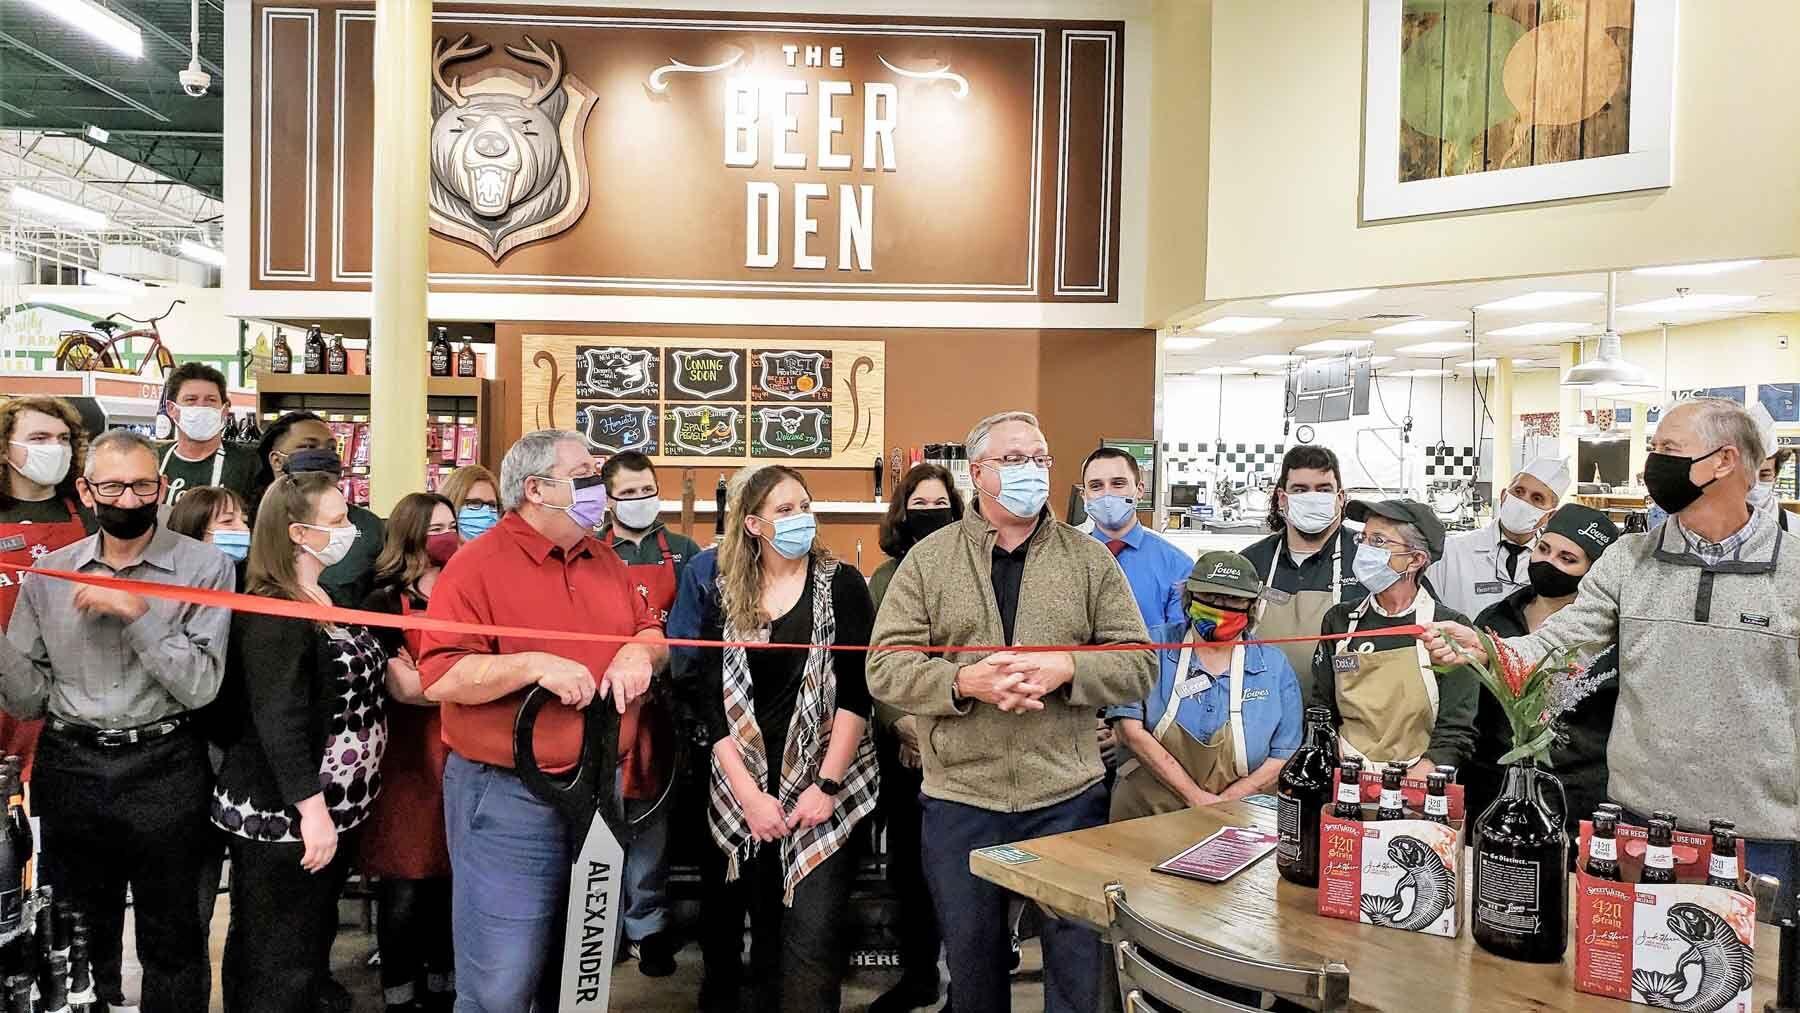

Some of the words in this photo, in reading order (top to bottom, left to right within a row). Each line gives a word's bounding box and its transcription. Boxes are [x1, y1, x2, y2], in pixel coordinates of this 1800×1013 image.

[782, 45, 845, 67] THE
[724, 78, 897, 172] BEER
[744, 181, 875, 271] DEN
[685, 355, 723, 370] COMING
[690, 370, 717, 381] SOON
[682, 423, 710, 432] SPACE
[1578, 522, 1611, 544] Lowes
[1207, 563, 1241, 579] Lowes
[1241, 687, 1271, 702] Lowes
[1328, 833, 1353, 852] 420
[1617, 827, 1630, 838] FOR
[1676, 834, 1690, 844] USE
[1690, 836, 1707, 846] ONLY
[1328, 849, 1353, 861] Strain
[1592, 898, 1622, 919] 420
[1592, 914, 1622, 928] Strain
[576, 860, 611, 1006] ALEXANDER
